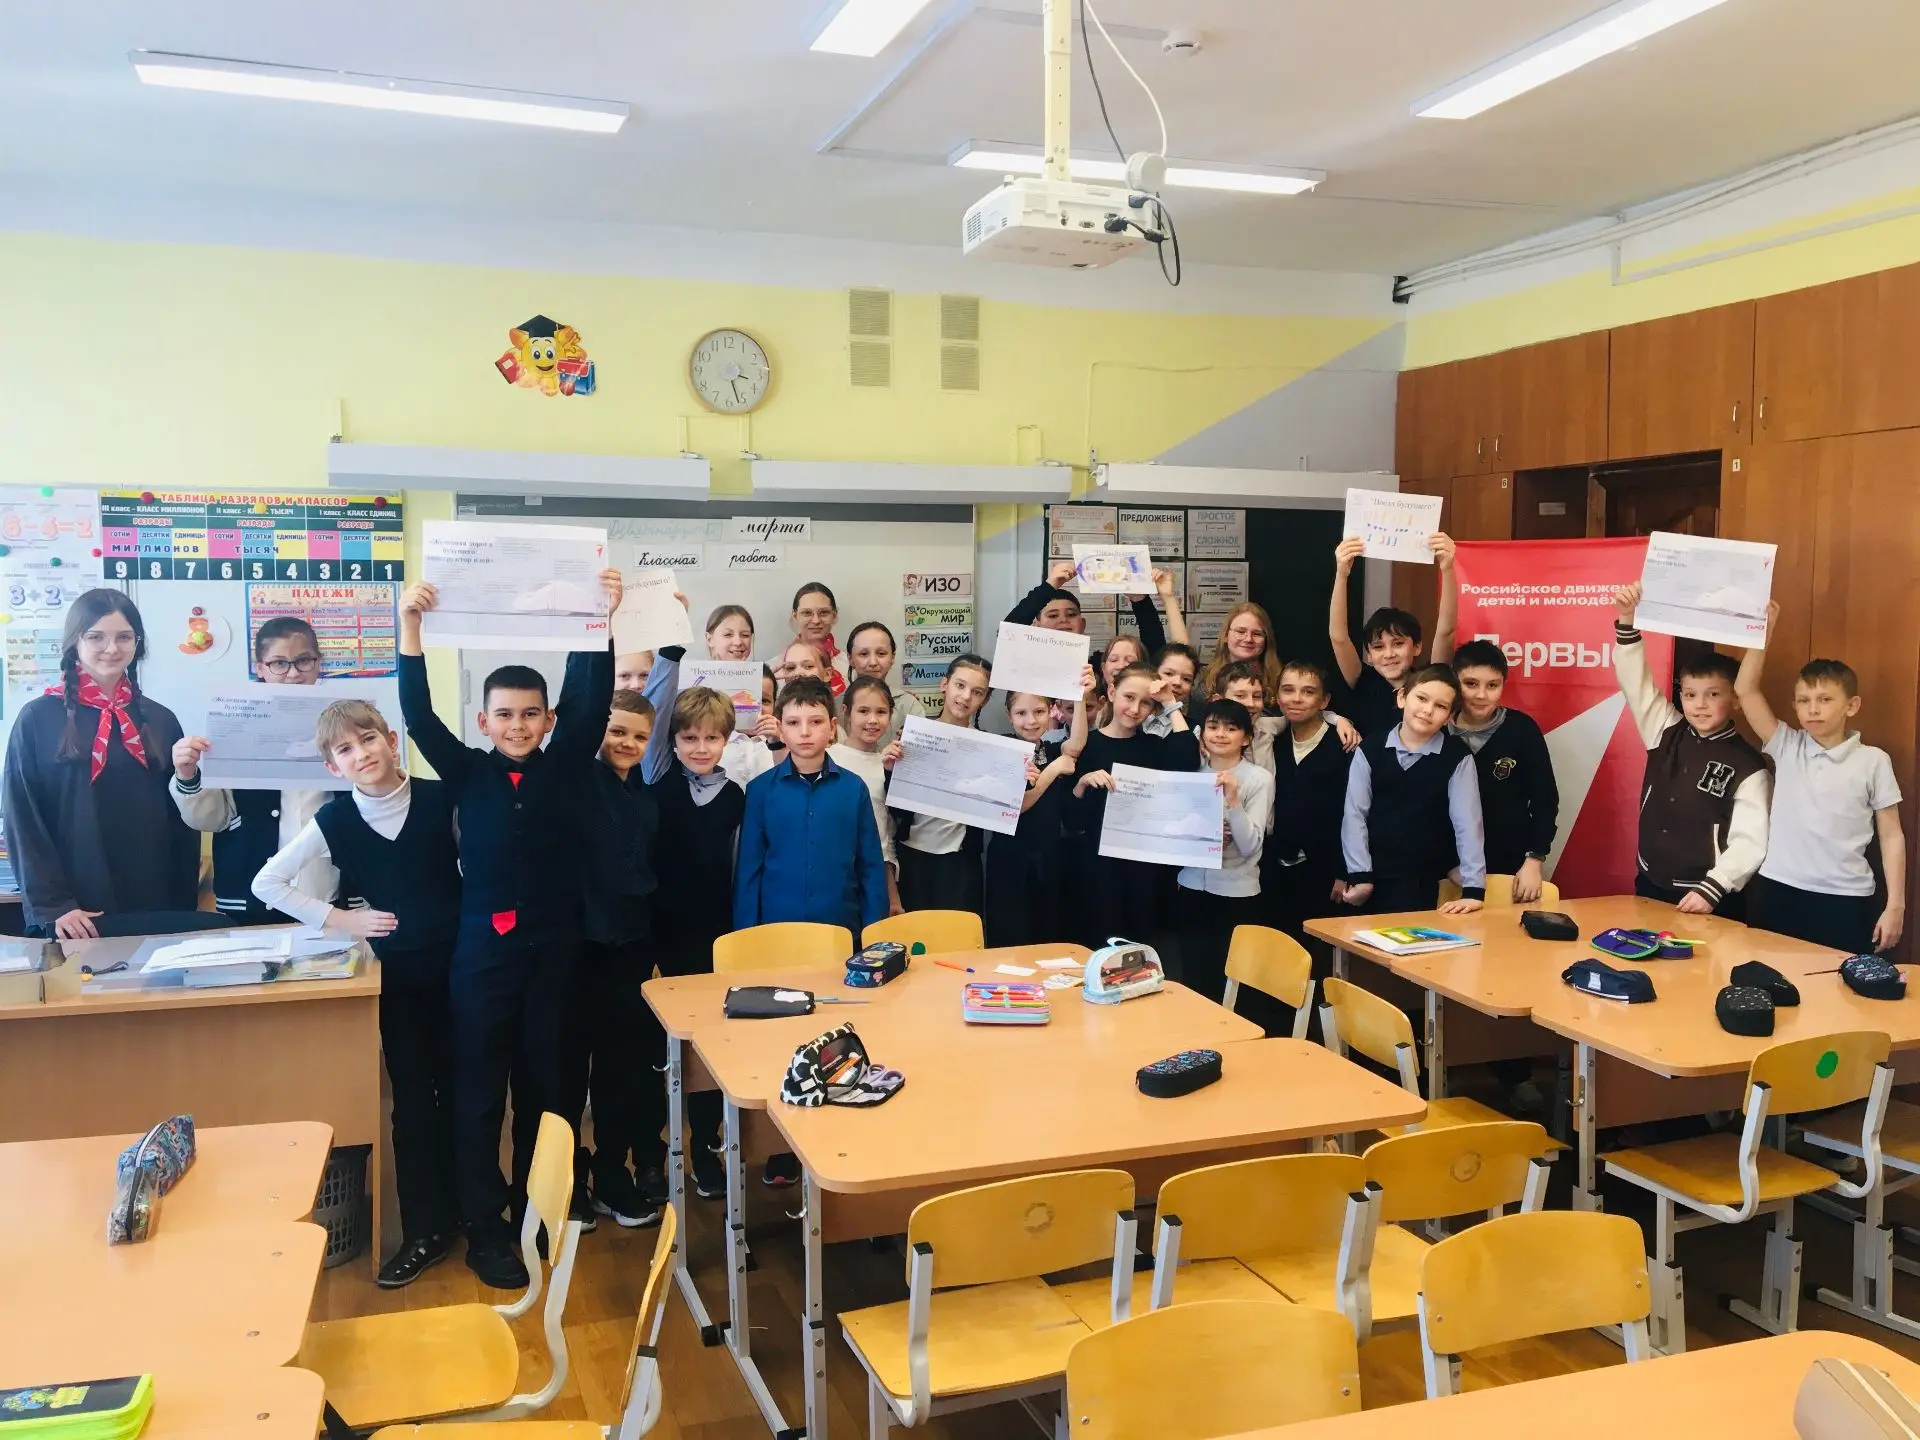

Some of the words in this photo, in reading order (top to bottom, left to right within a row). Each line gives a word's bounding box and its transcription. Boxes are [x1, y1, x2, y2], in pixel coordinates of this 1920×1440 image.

[723, 336, 734, 349] 12
[698, 351, 711, 362] 10
[751, 353, 757, 365] 2
[694, 365, 703, 376] 9
[712, 390, 720, 402] 7
[725, 396, 733, 407] 6
[740, 391, 747, 404] 5
[161, 493, 216, 504] ТАБЛИЦА
[221, 495, 281, 505] РАЗРЯДОВ
[286, 496, 293, 505] И
[297, 496, 348, 506] КЛАССОВ
[1120, 514, 1183, 523] ПРЕДЛОЖЕНИЕ
[1197, 511, 1236, 521] ПРОСТОЕ
[3, 515, 21, 537] 6
[76, 516, 93, 538] 2
[1196, 536, 1239, 545] СЛОЖНОЕ
[729, 548, 778, 569] работа
[115, 561, 127, 578] 9
[150, 562, 161, 578] 8
[185, 562, 196, 578] 7
[221, 563, 232, 578] 6
[252, 563, 263, 579] 5
[286, 563, 297, 579] 4
[319, 563, 331, 579] 3
[351, 563, 362, 579] 2
[384, 564, 393, 580] 1
[925, 577, 961, 592] ИЗО
[1461, 583, 1561, 594] Российское
[1564, 584, 1620, 595] движе
[9, 585, 25, 605] 3
[45, 585, 61, 605] 2
[291, 588, 354, 598] ПАДЕЖИ
[1477, 595, 1526, 607] детей
[1543, 594, 1617, 607] молодёж
[919, 606, 971, 616] Окружающий
[941, 614, 965, 625] мир
[920, 632, 970, 648] Русский
[932, 645, 961, 654] язык
[915, 668, 946, 679] Матем
[923, 696, 945, 707] Чте
[1696, 760, 1736, 798] H
